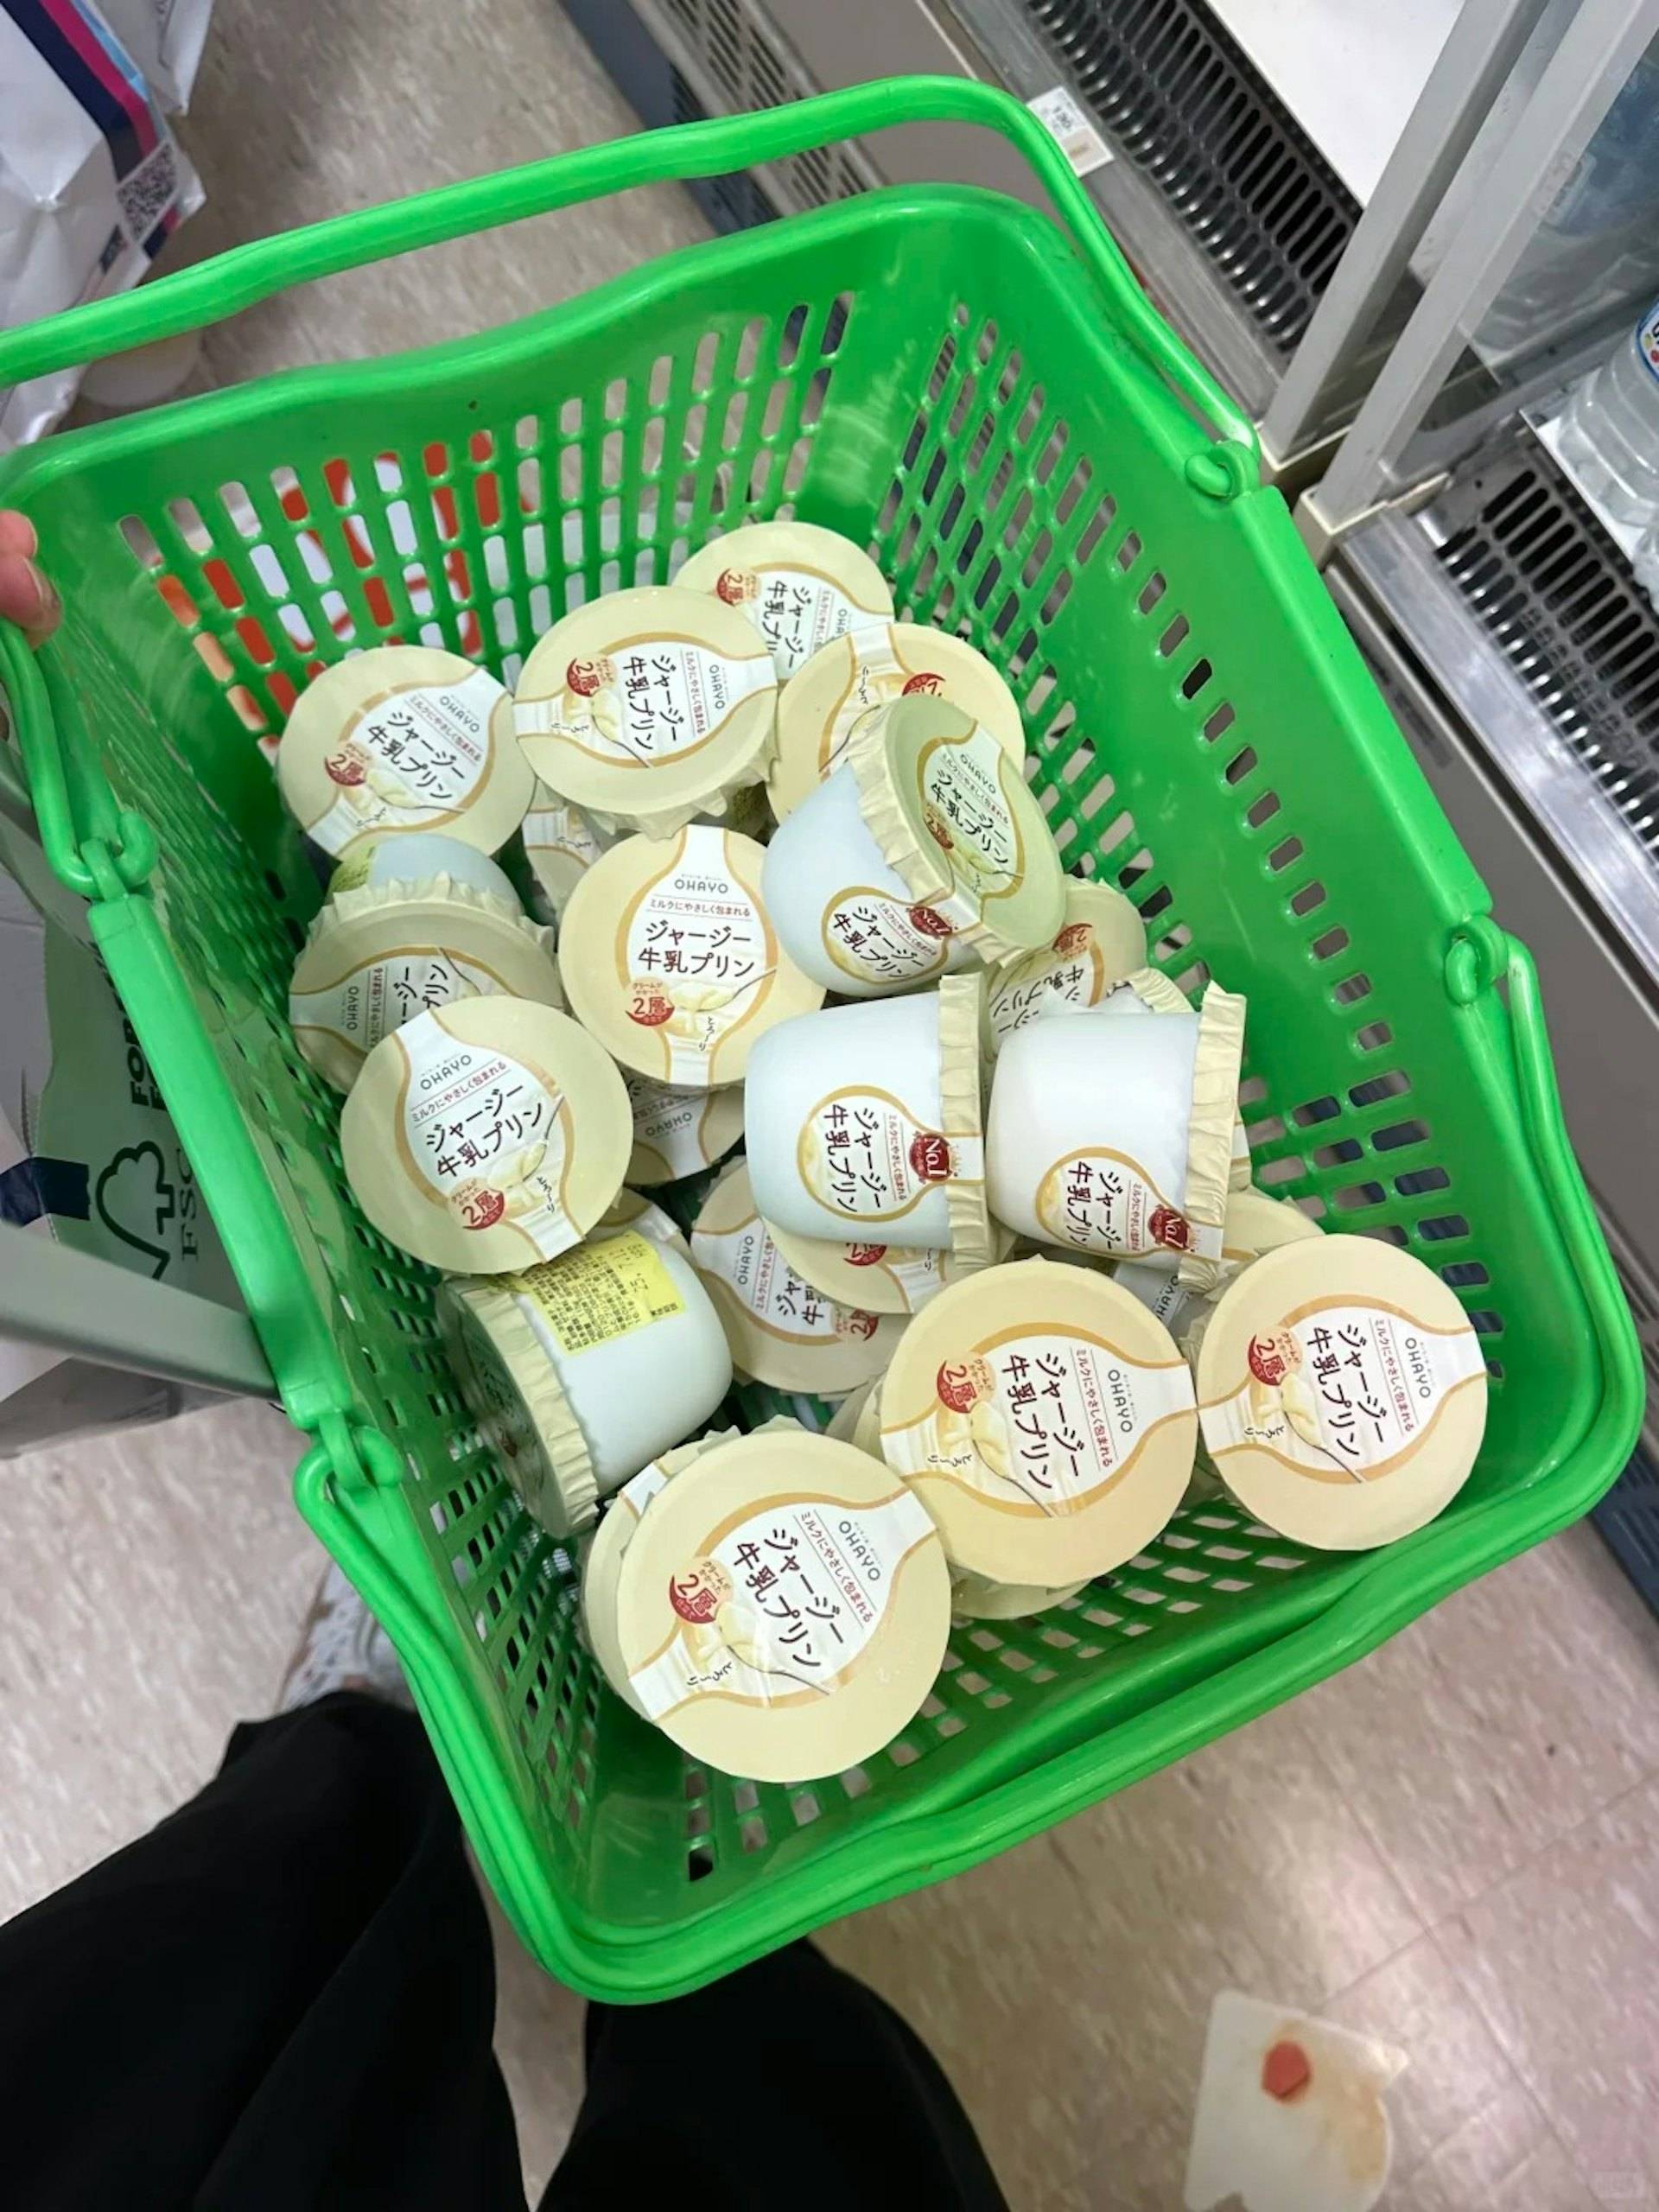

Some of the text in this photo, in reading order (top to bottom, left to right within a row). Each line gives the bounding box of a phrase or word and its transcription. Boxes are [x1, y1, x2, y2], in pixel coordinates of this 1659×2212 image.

[762, 581, 788, 651] 牛乳プリ
[789, 588, 812, 668] ジャージー
[835, 608, 849, 635] OHA
[575, 661, 600, 692] 2層
[622, 657, 655, 750] 牛乳プリン
[652, 654, 684, 741] ジャージー
[709, 664, 727, 709] OHAYO
[386, 712, 465, 779] ジャージー
[439, 696, 480, 733] OHAYO
[368, 726, 452, 798] 牛乳プリン
[960, 753, 997, 794] OHAYO
[931, 783, 1008, 863] 牛乳プリン
[937, 768, 1007, 843] ジャージー
[650, 898, 751, 917] ミルクにやさしく包まれる
[673, 879, 729, 895] OHAYO
[638, 947, 754, 978] 牛乳プリン
[645, 919, 751, 948] ジャージー
[833, 913, 911, 977] 牛乳プリン
[852, 906, 925, 967] ジャージー
[347, 986, 359, 1030] OHAYO
[393, 966, 417, 1021] ージー
[422, 964, 449, 1009] プリン
[632, 996, 666, 1016] 2層
[412, 1060, 508, 1122] ミルクにやさしく包まれる
[420, 1054, 473, 1090] OHAYO
[426, 1085, 524, 1153] ジャージー
[437, 1103, 542, 1178] 牛乳プリン
[645, 1112, 693, 1136] OHAYO
[823, 1104, 857, 1212] 牛乳プリン
[854, 1108, 887, 1208] ジャージー
[925, 1139, 948, 1177] No.1
[462, 1190, 498, 1225] 2層
[1066, 1161, 1093, 1247] 牛乳プリン
[1096, 1172, 1123, 1249] ジャージー
[738, 1236, 754, 1285] OHAYO
[946, 1364, 976, 1407] 2層
[1256, 1338, 1286, 1378] 2層
[1338, 1324, 1386, 1443] ジャージー
[1375, 1319, 1414, 1432] ミルクにやさしく包まれる
[1405, 1338, 1432, 1399] OHAYO
[1002, 1354, 1052, 1489] 牛乳プリン
[1035, 1353, 1084, 1477] ジャージー
[1077, 1349, 1113, 1468] ミルクにやさしく包まれる
[1107, 1369, 1134, 1433] OHAYO
[1307, 1327, 1360, 1455] 牛乳プリン
[801, 1513, 874, 1624] ミルクにやさしく包まれる
[838, 1520, 881, 1581] OHAYO
[677, 1573, 717, 1617] 2層
[734, 1542, 821, 1666] 牛乳プリン
[764, 1529, 844, 1643] ジャージー
